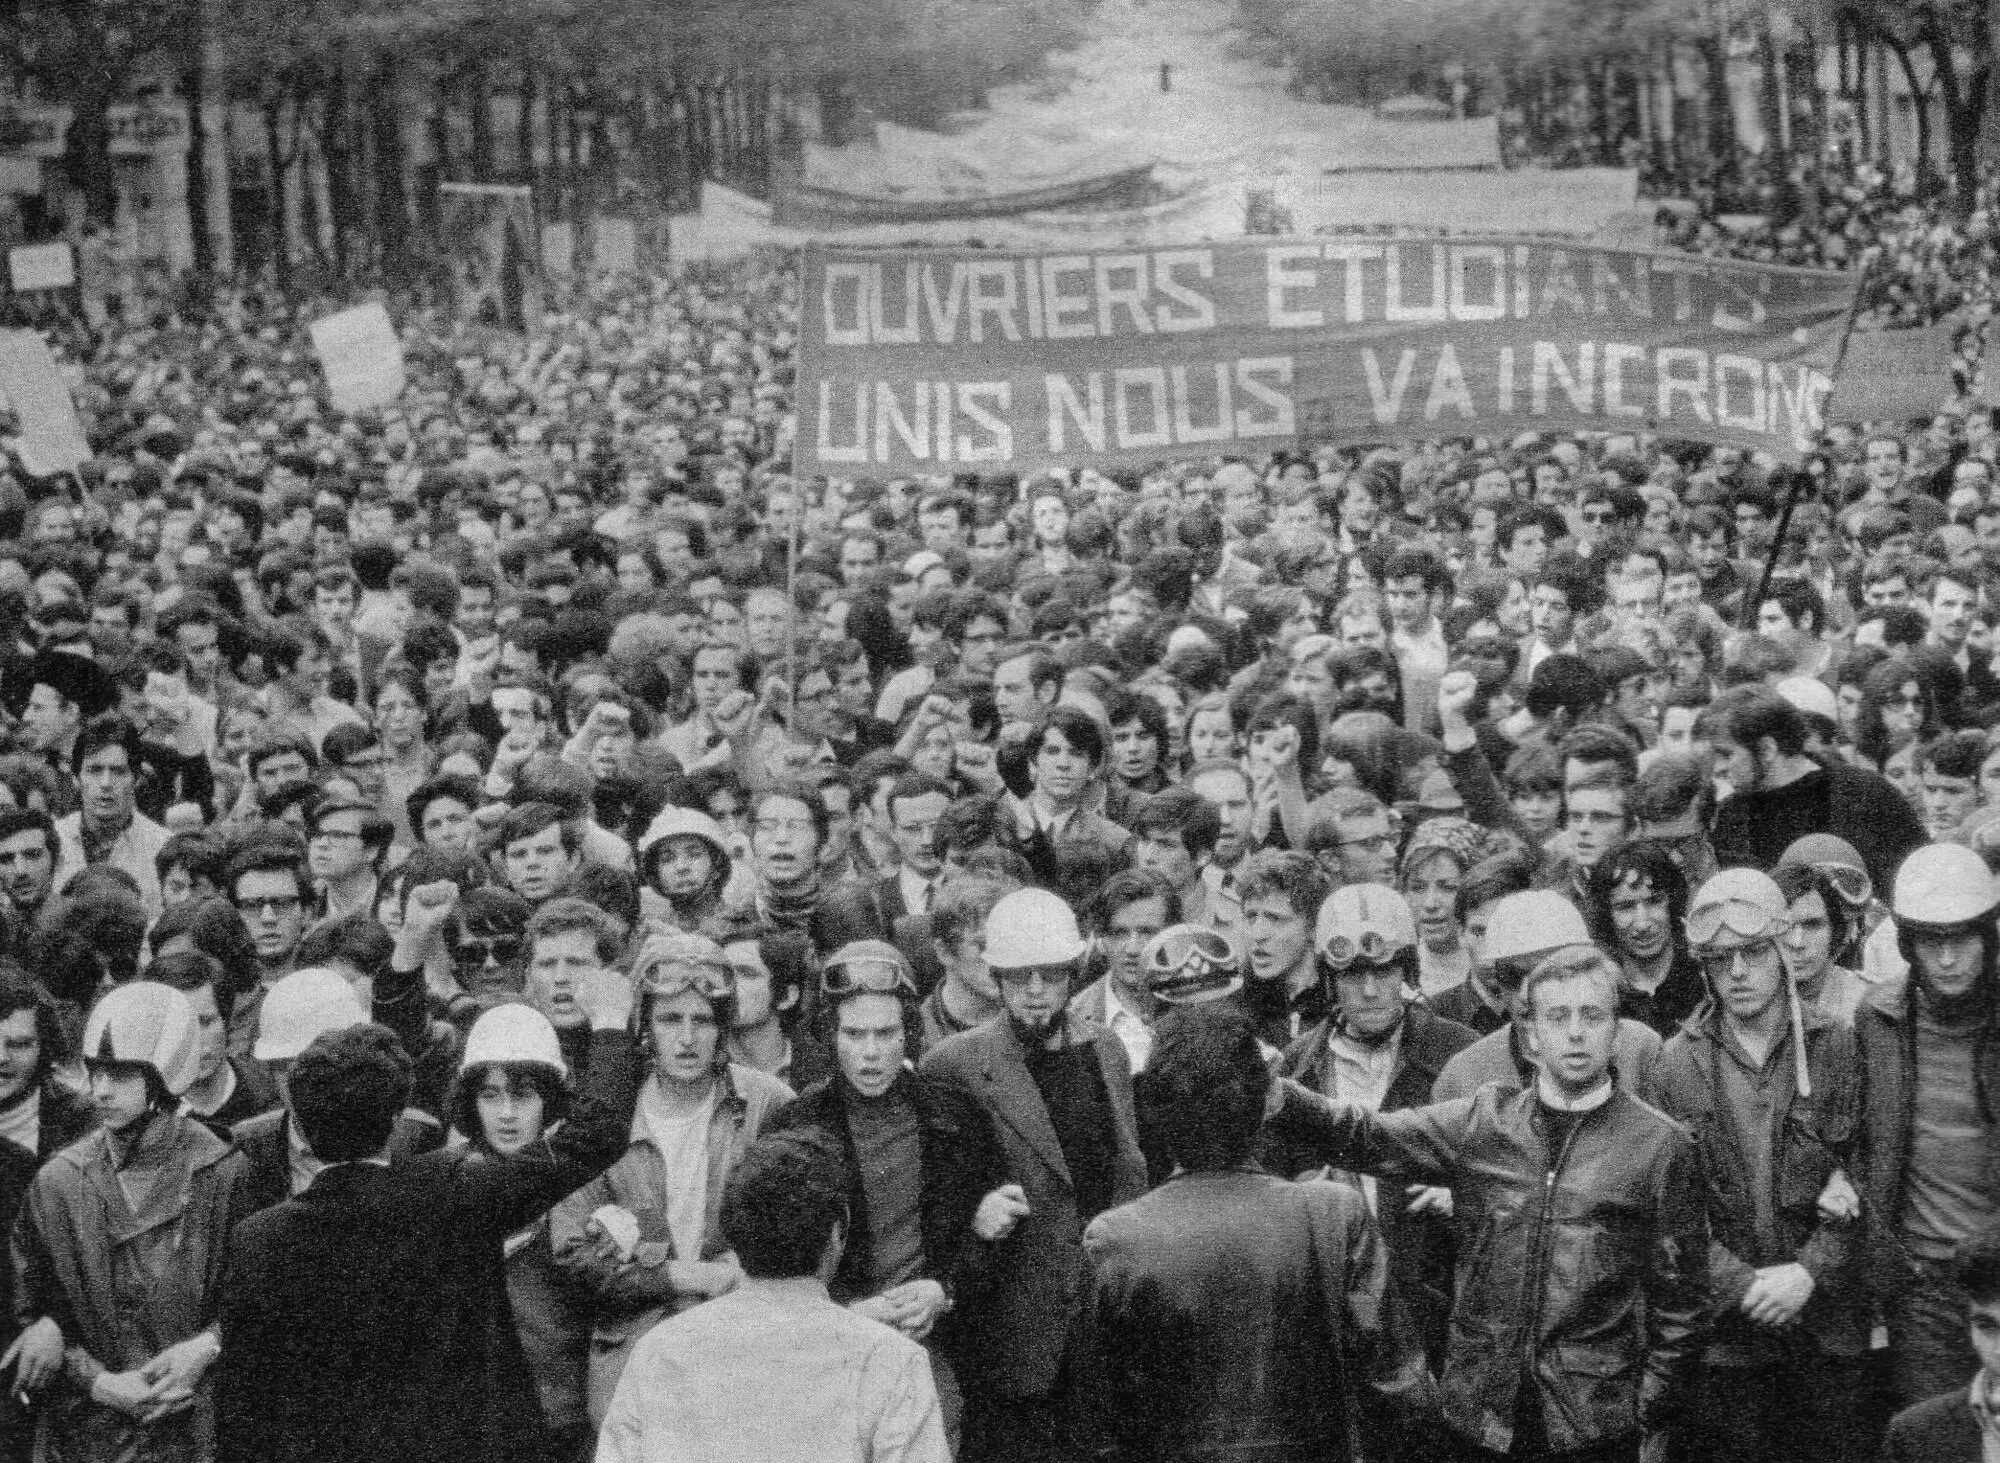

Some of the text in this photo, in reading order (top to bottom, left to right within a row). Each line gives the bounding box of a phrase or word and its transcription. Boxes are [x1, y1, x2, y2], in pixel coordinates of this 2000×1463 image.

[825, 243, 1770, 345] OUVRIERS ETUDIANTS
[816, 379, 1013, 462] UNIS
[1044, 355, 1295, 453] NOUS
